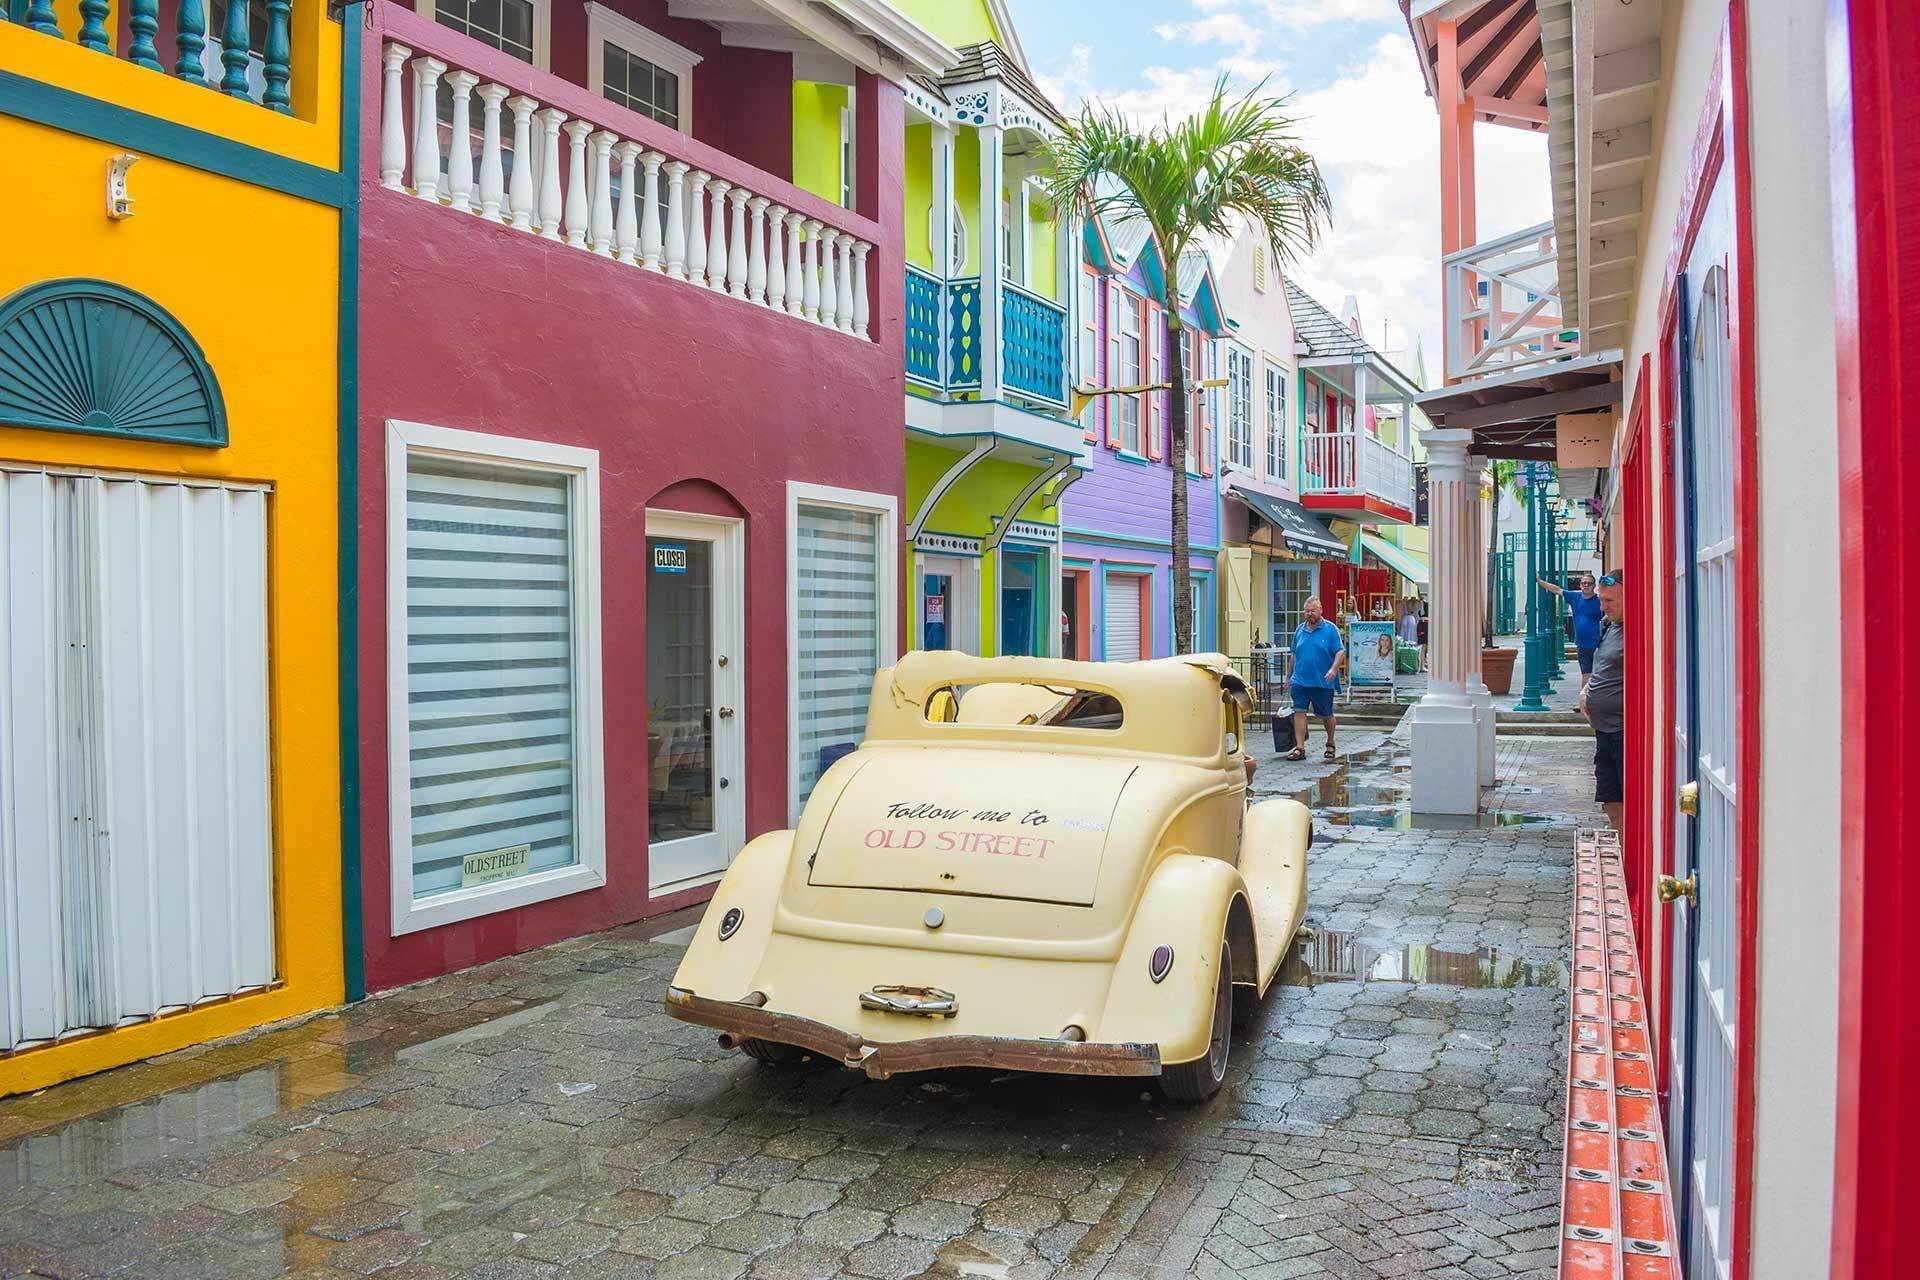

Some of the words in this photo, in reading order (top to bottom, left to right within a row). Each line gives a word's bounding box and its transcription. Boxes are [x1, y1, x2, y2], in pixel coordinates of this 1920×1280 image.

[656, 549, 685, 567] CLOSED
[887, 802, 969, 820] Follow
[972, 810, 1012, 823] me
[1020, 808, 1050, 826] to
[863, 829, 927, 849] OLD
[935, 831, 1056, 859] STREET
